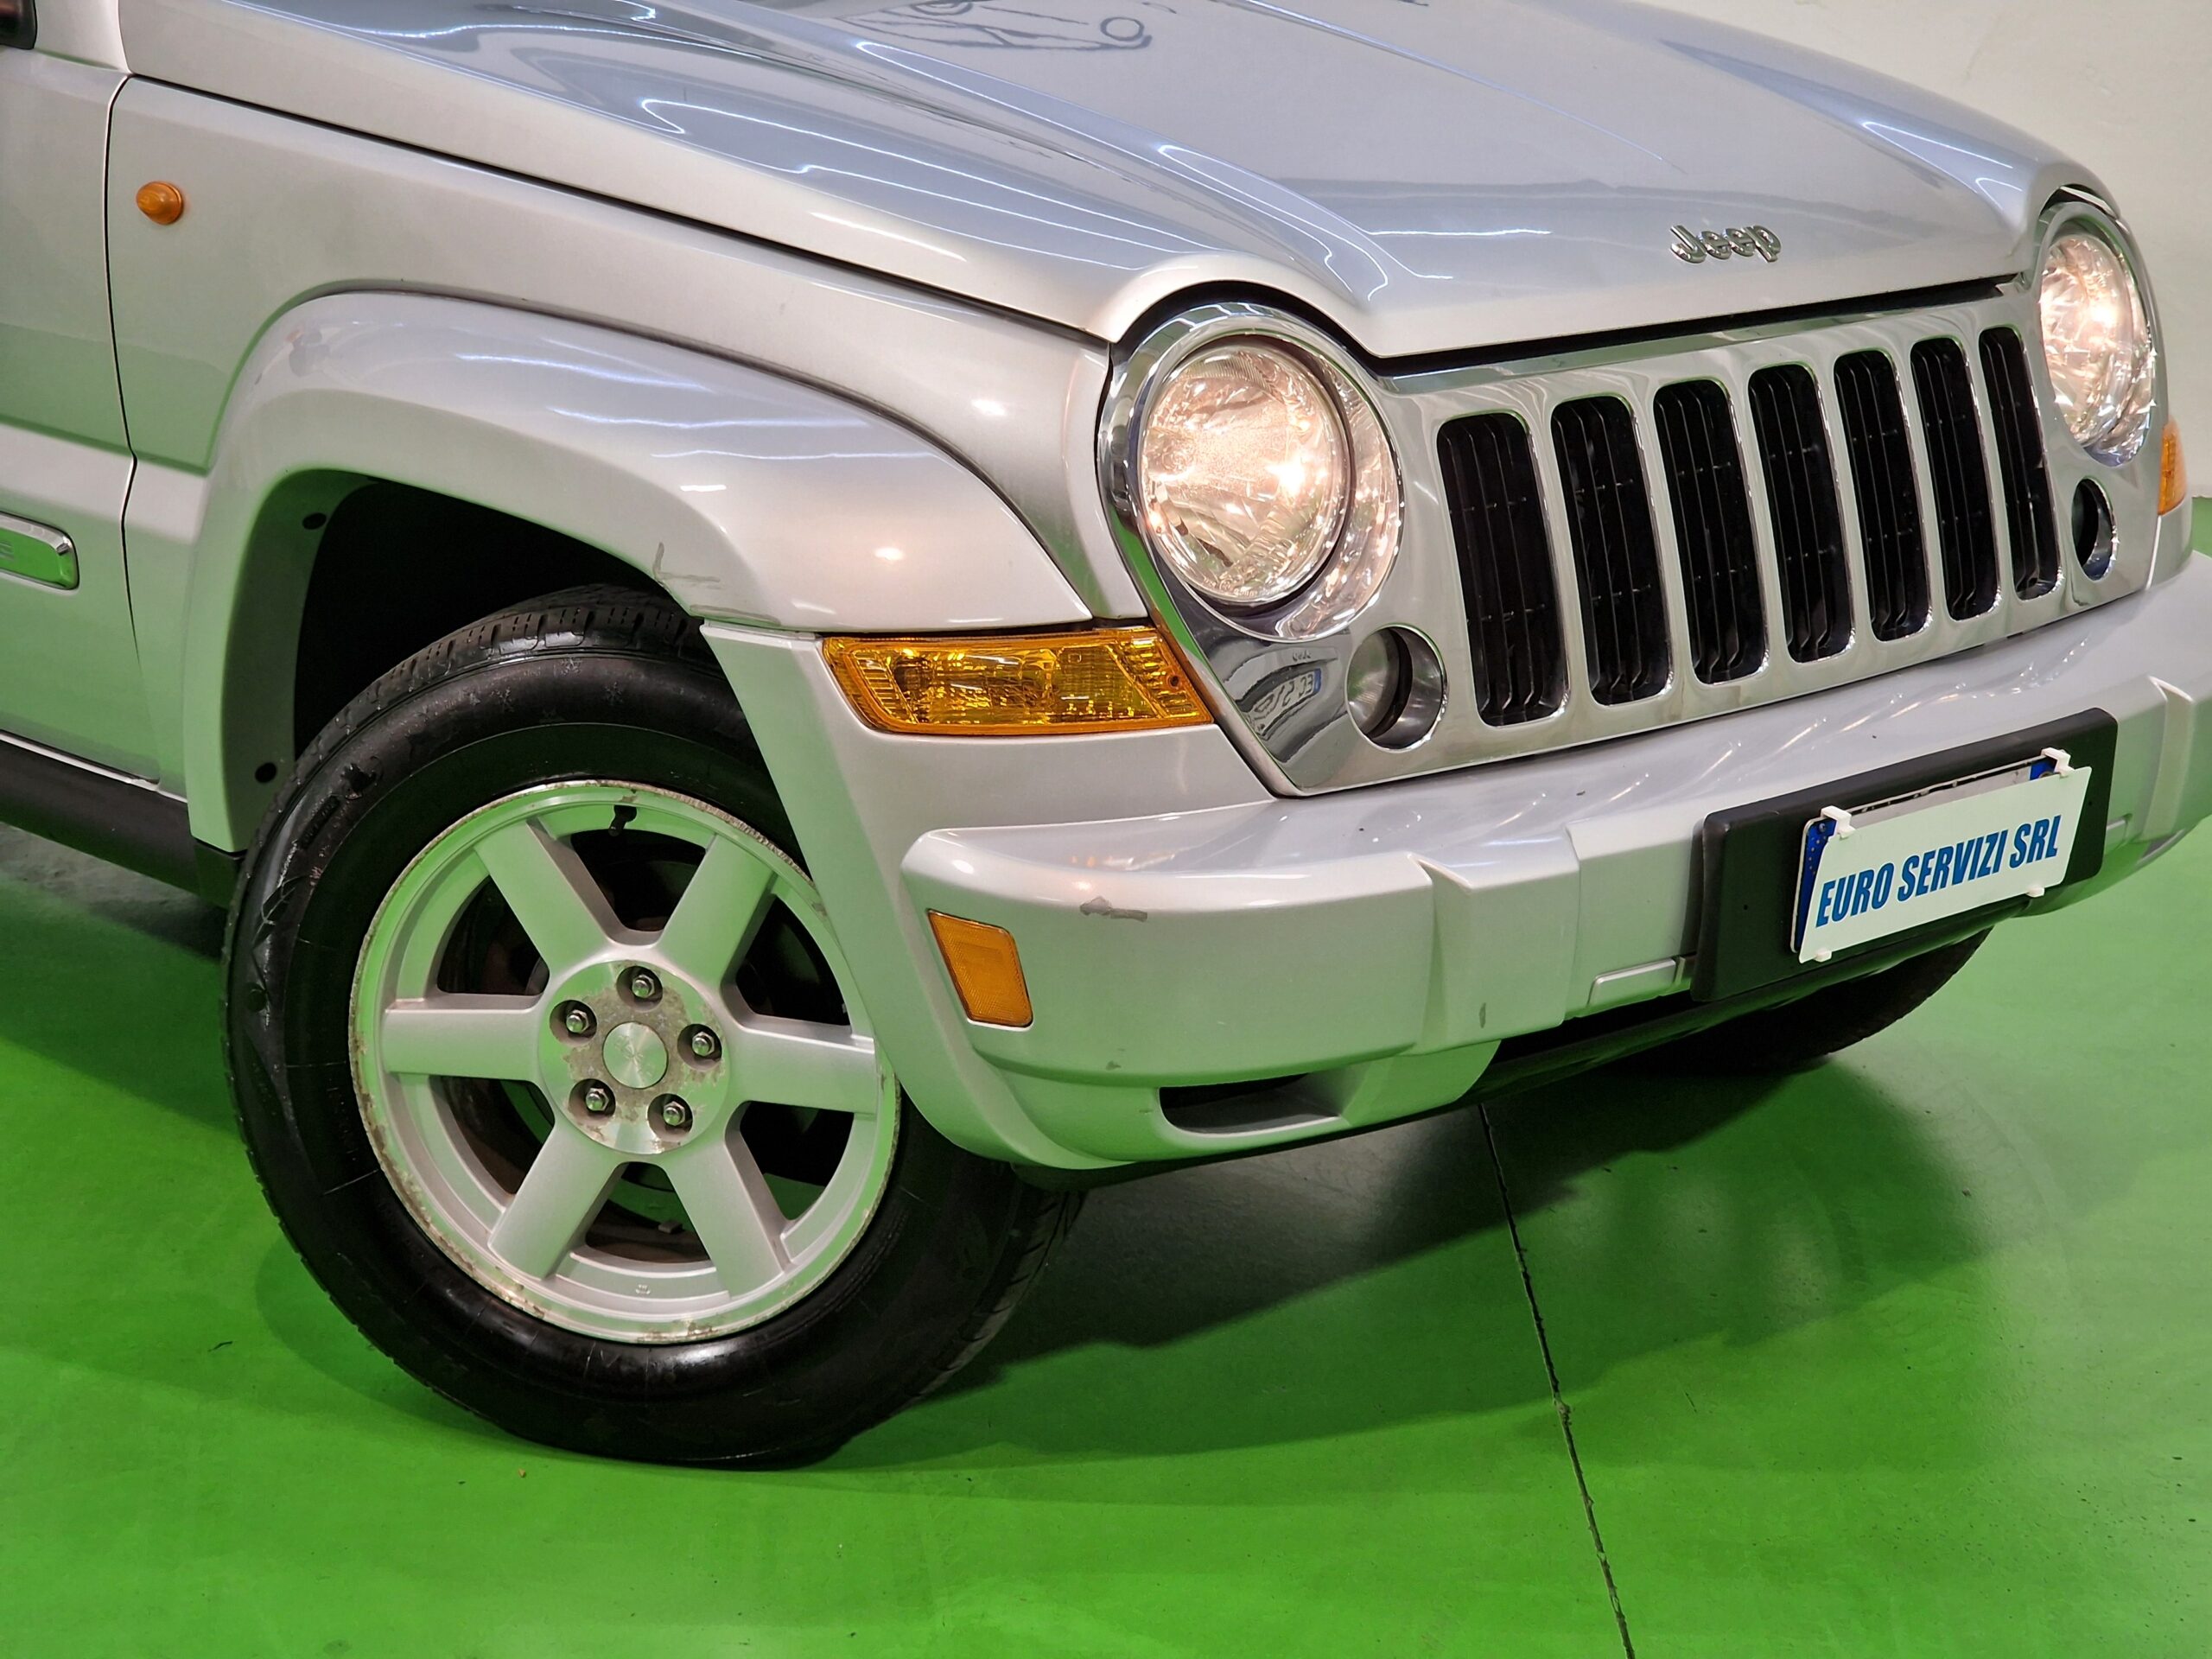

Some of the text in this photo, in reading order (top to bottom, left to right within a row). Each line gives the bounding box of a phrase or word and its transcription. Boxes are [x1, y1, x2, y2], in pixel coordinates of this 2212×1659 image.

[1669, 224, 1782, 264] Jeep
[1815, 814, 2063, 928] EURO SERVIZI SRL
